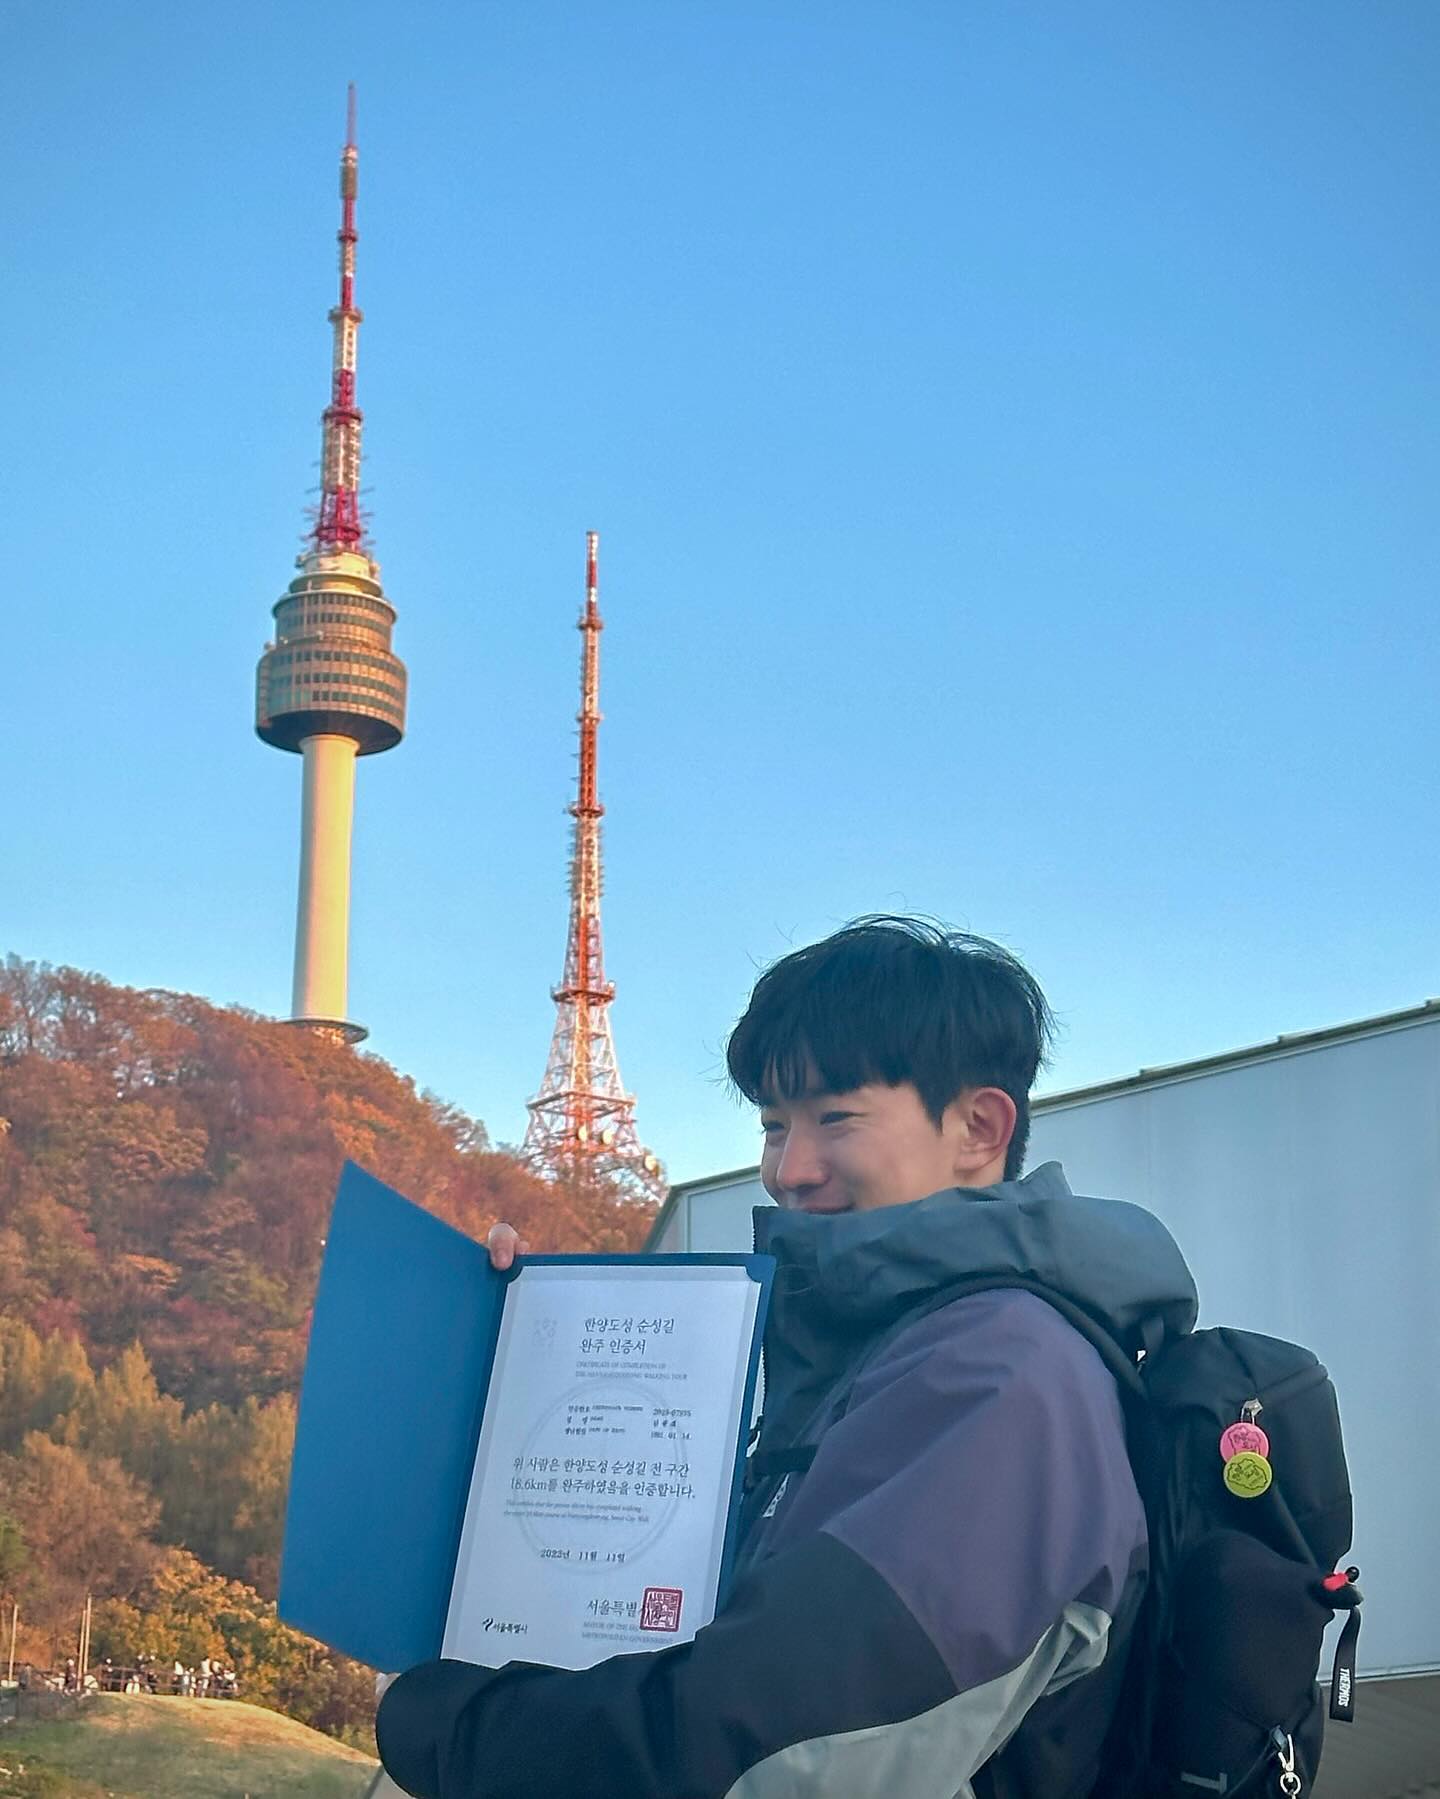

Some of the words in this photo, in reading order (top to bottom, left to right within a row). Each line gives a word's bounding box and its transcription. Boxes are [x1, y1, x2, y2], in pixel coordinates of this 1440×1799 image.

[584, 1317, 634, 1334] 한양도성
[637, 1318, 675, 1334] 순성길
[580, 1338, 606, 1354] 완주
[609, 1339, 647, 1355] 인증서
[514, 1456, 524, 1472] 위
[528, 1457, 560, 1472] 사람은
[564, 1458, 608, 1473] 한양도성
[611, 1460, 647, 1475] 순성길
[651, 1461, 662, 1476] 전
[665, 1463, 689, 1478] 구간
[562, 1479, 630, 1495] 완주하였음을
[634, 1481, 695, 1499] 인증합니다.
[1337, 1667, 1351, 1707] THERMOS
